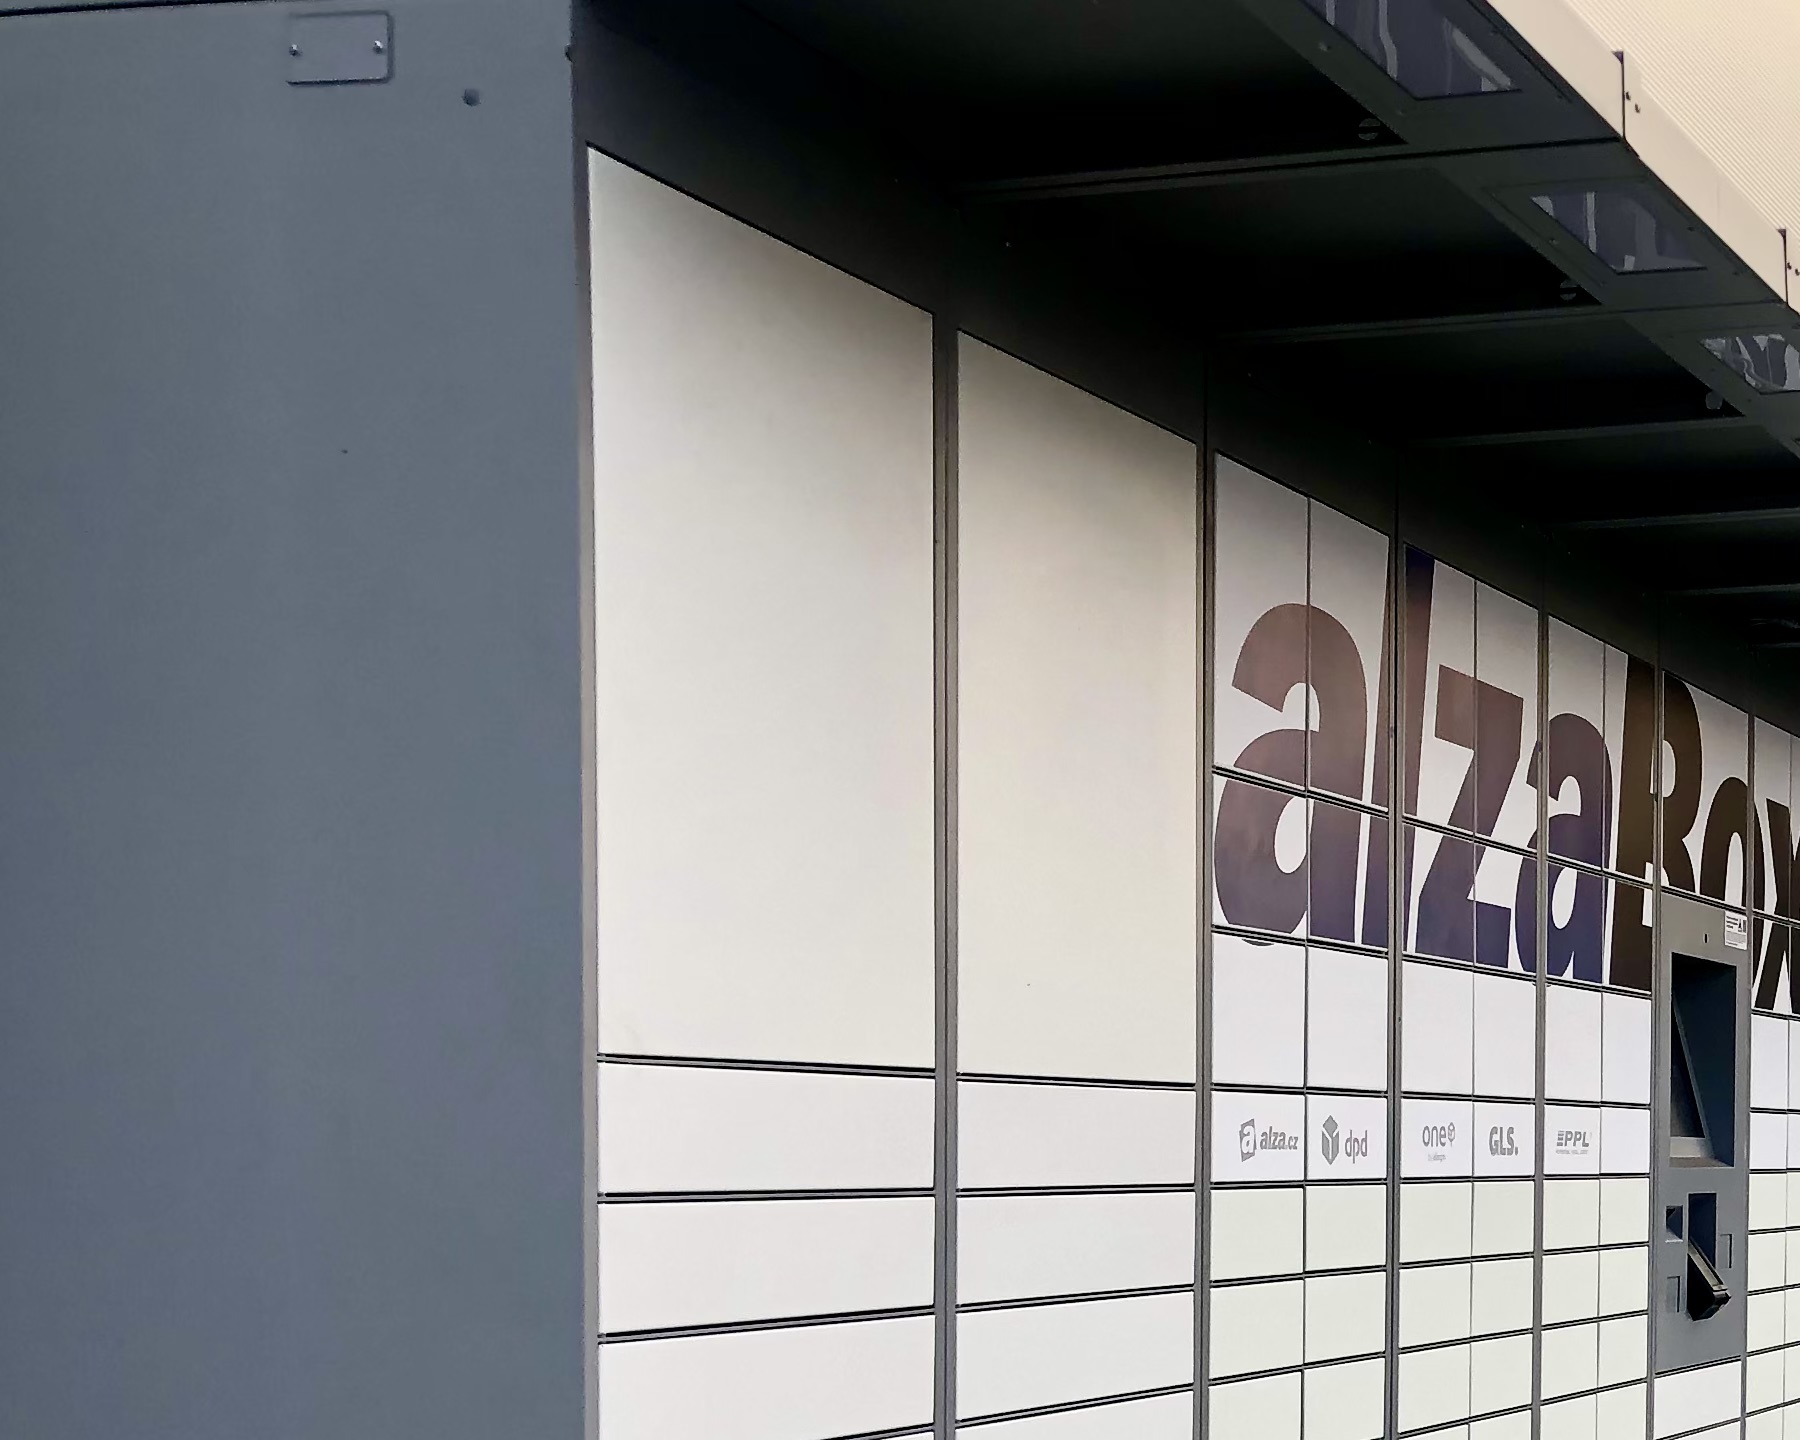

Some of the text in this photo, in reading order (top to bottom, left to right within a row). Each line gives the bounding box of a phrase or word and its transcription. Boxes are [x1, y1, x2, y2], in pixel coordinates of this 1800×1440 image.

[1259, 1125, 1299, 1151] alza.cz
[1344, 1129, 1368, 1164] dpd
[1422, 1125, 1447, 1148] one
[1564, 1130, 1590, 1147] PPL
